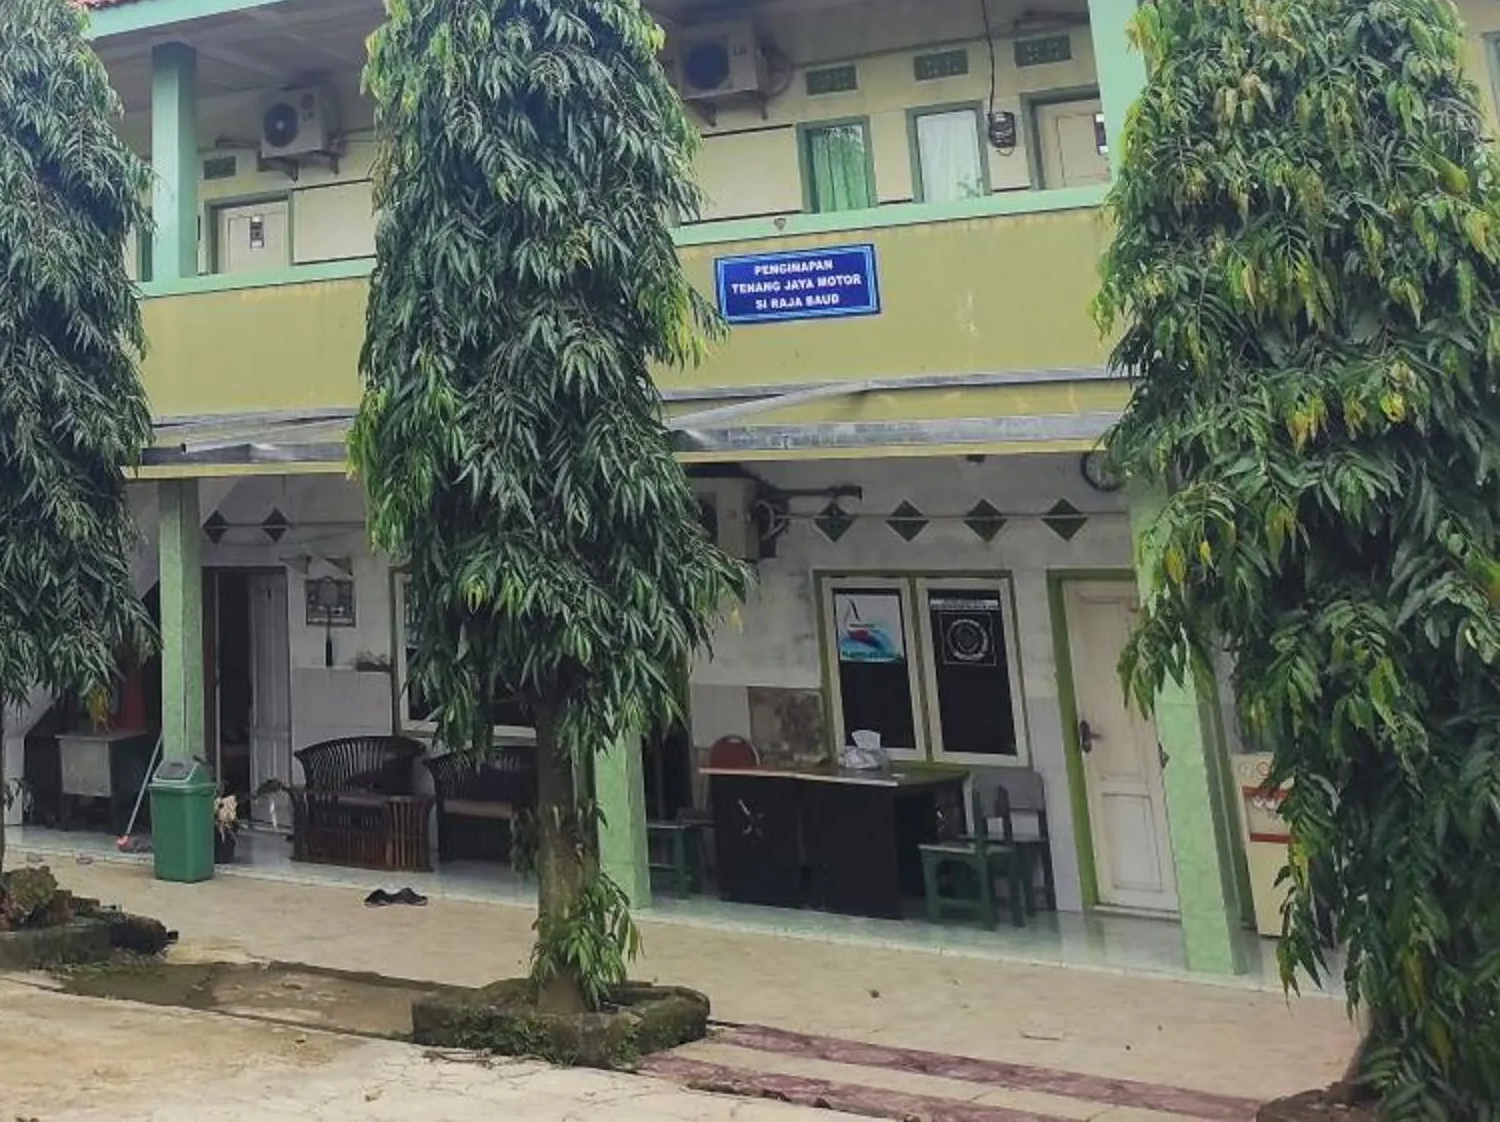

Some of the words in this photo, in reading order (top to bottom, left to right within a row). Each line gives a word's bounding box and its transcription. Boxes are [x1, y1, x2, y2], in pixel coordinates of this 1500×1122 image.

[754, 259, 833, 276] PENGINAPAN
[731, 281, 781, 295] TENANG
[784, 278, 815, 291] JAYA
[817, 273, 862, 287] MOTOR
[755, 298, 767, 310] SI
[771, 296, 803, 309] RAJA
